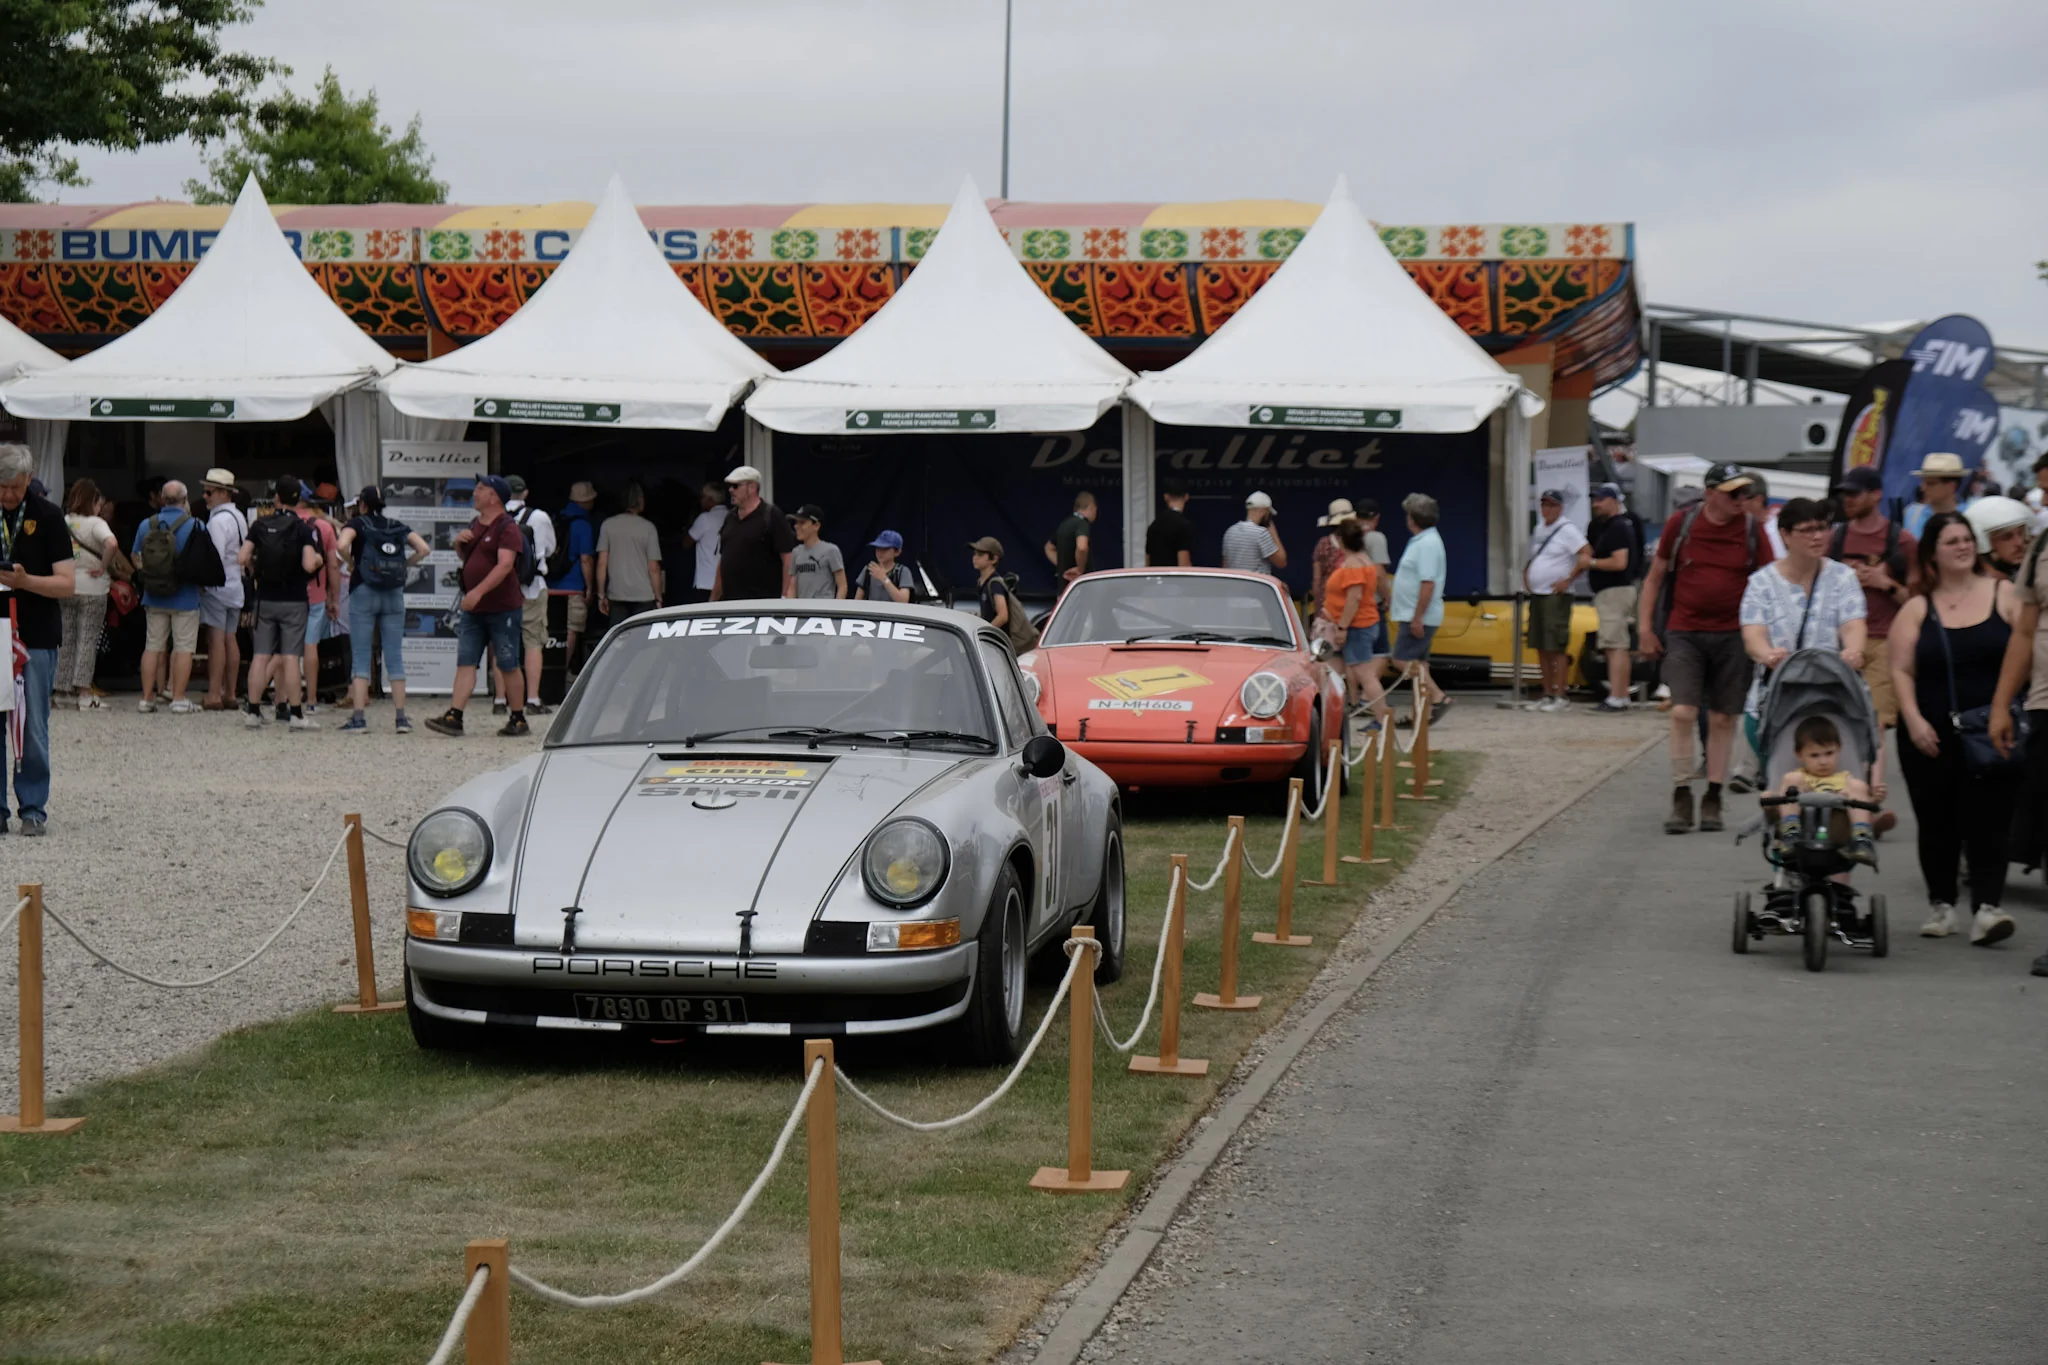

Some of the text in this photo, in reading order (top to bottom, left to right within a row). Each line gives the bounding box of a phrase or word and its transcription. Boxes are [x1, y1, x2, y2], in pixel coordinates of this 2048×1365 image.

[62, 230, 698, 261] BUMP CS
[1909, 339, 1987, 381] FIM
[542, 403, 584, 411] MANUFACTURE
[388, 450, 482, 465] Devalliet
[1030, 432, 1384, 470] Dealliet
[648, 616, 925, 643] MEZNARIE
[637, 787, 801, 800] Shell
[668, 777, 812, 787] DUNLOP
[1045, 799, 1058, 910] 31
[533, 957, 777, 980] PORSCHE
[585, 996, 733, 1022] 7890 QP 91
